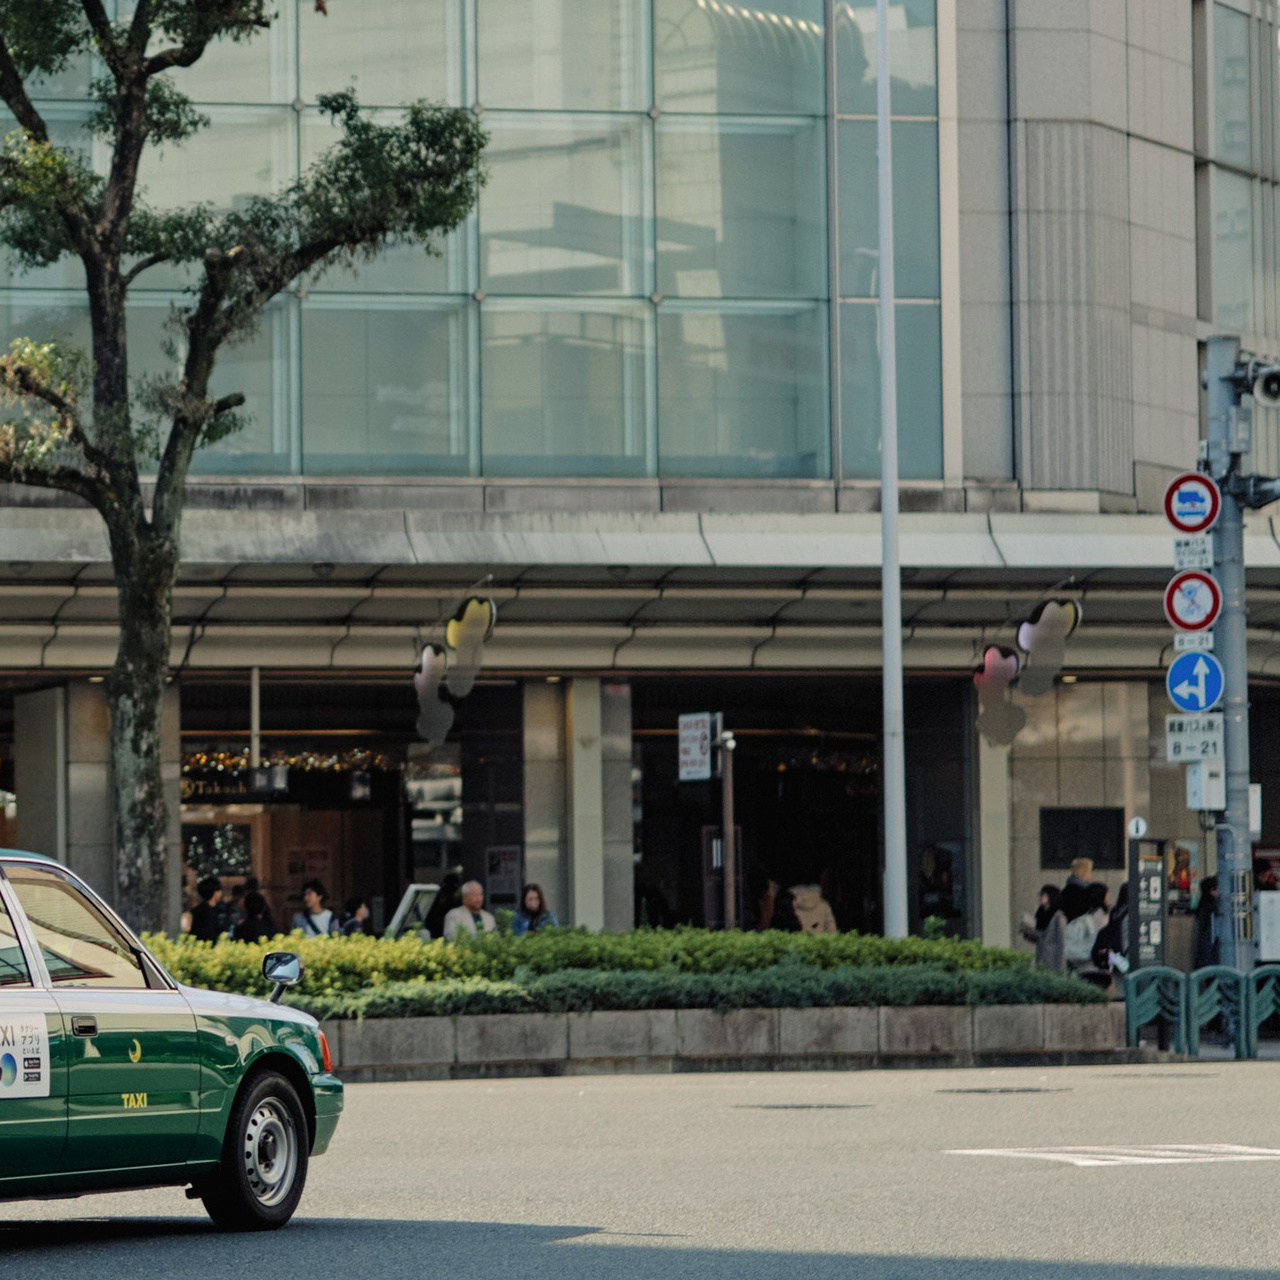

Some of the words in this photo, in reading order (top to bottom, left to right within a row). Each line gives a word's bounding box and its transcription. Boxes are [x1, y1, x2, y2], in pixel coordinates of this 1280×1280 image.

[20, 1034, 41, 1046] アプリ
[121, 1092, 148, 1109] TAXI
